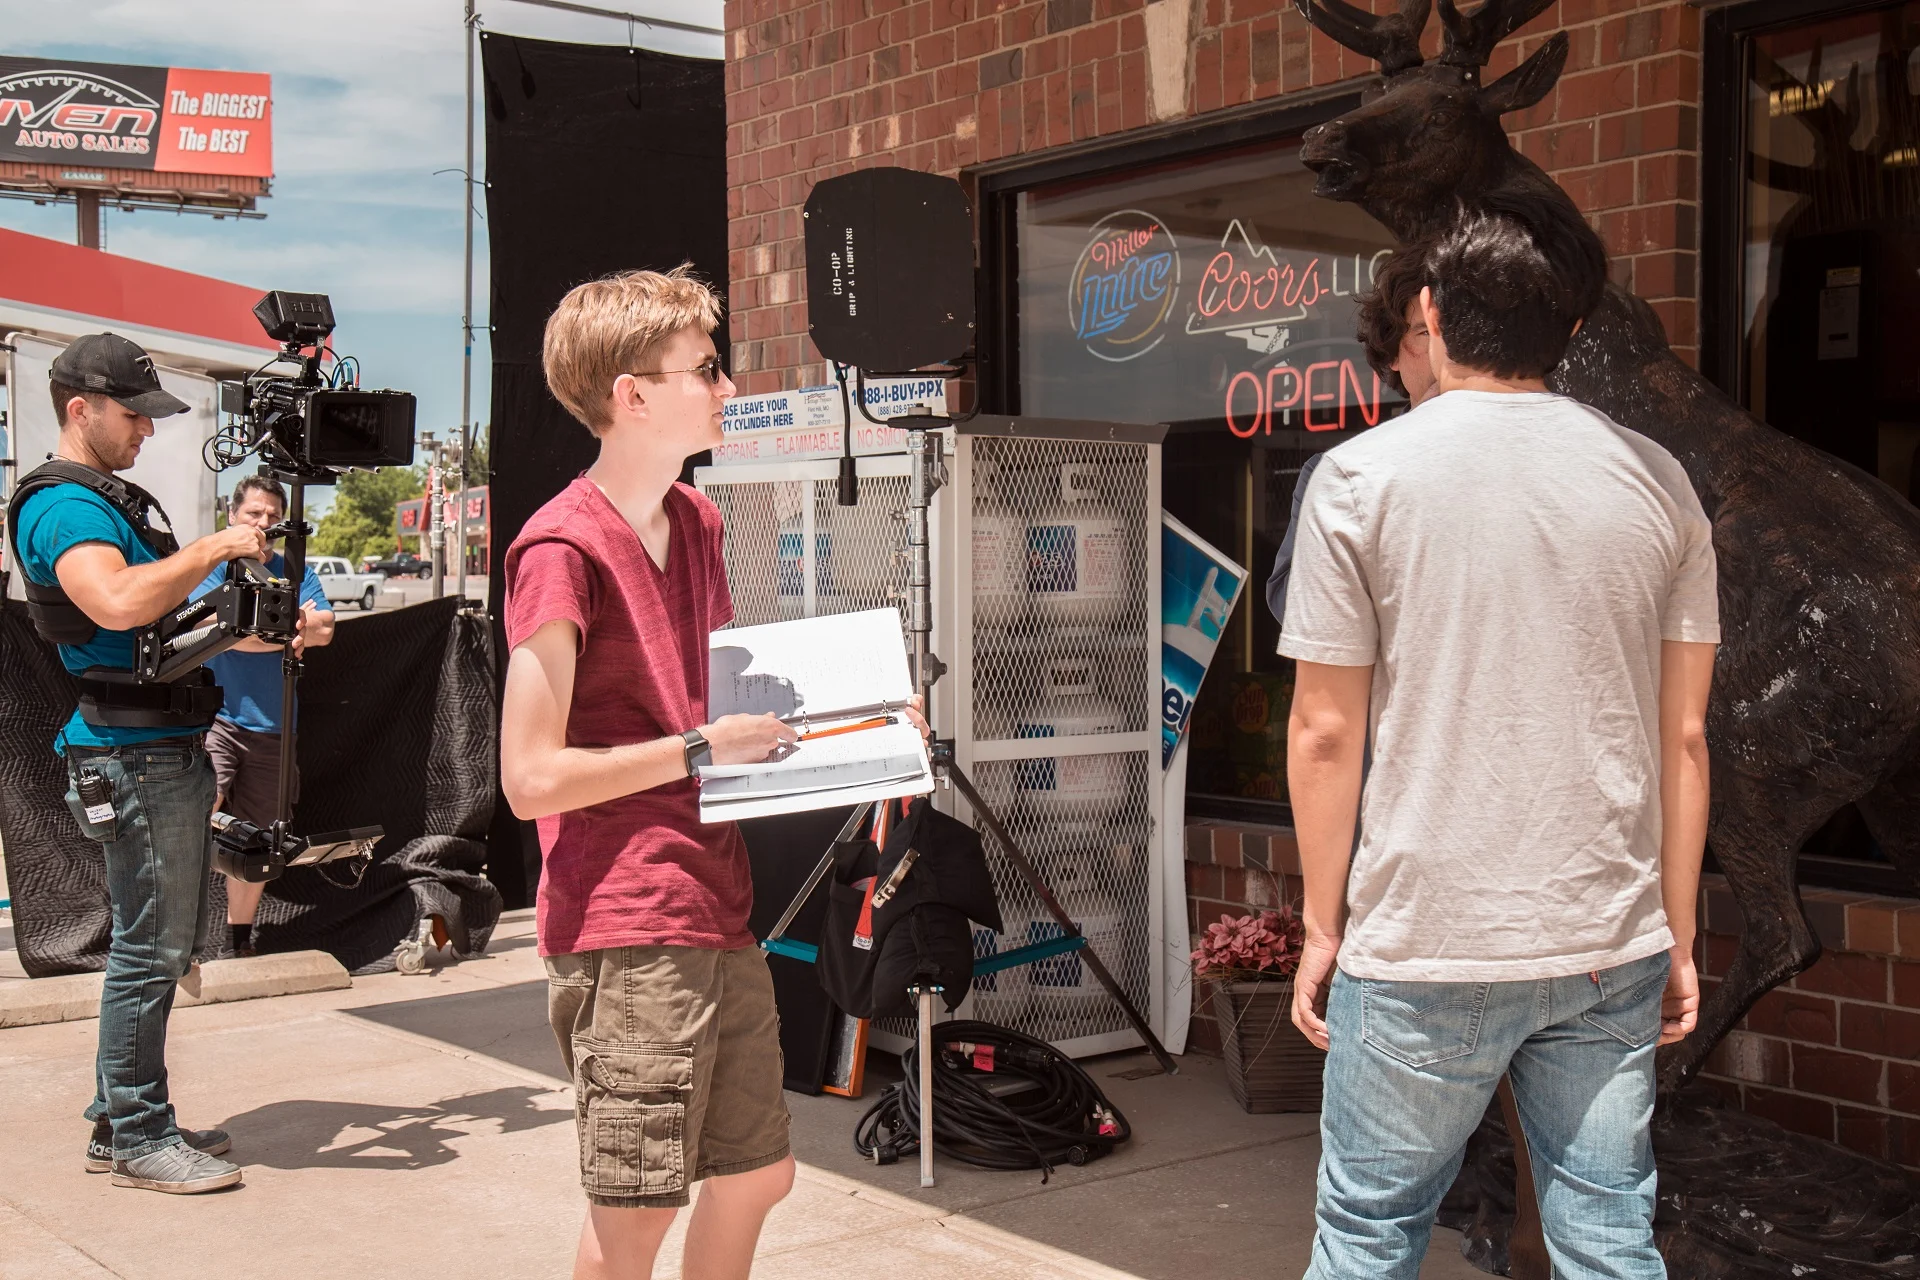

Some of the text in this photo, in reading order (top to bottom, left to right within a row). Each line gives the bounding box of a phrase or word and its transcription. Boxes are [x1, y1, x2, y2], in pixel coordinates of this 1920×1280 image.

[170, 90, 268, 120] The BIGGEST
[15, 129, 150, 154] AUTO SALES
[178, 126, 249, 154] The BEST
[846, 227, 855, 275] LIGHTING
[1091, 224, 1160, 271] Miller
[831, 252, 842, 295] CO-OP
[849, 292, 857, 316] GRIP
[740, 401, 764, 415] LEAVE
[766, 398, 788, 412] YOUR
[851, 379, 944, 406] 188-I-BUY-PPX
[1226, 359, 1380, 438] OPEN
[734, 415, 771, 431] CYLINDER
[773, 413, 794, 427] HERE
[892, 403, 919, 414] 428-9
[713, 440, 759, 461] PROPANE
[776, 432, 841, 456] FLAMMABLE
[857, 428, 874, 449] NO
